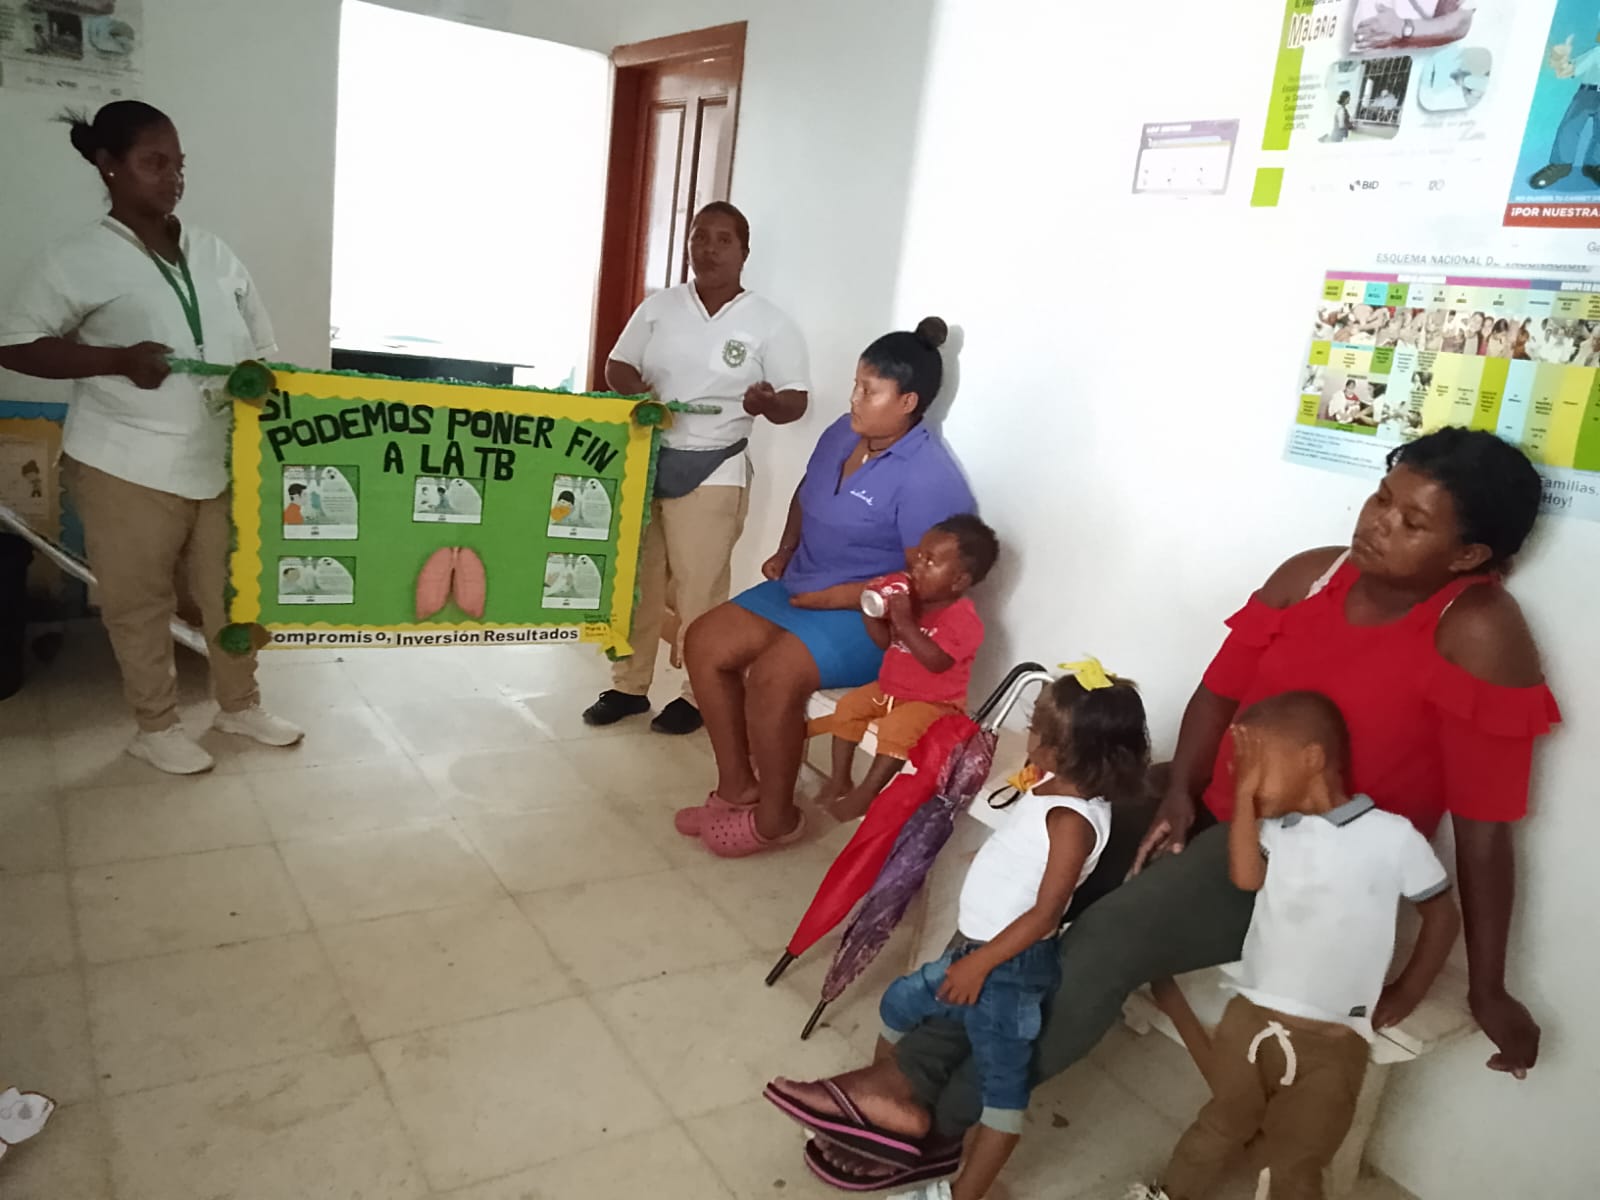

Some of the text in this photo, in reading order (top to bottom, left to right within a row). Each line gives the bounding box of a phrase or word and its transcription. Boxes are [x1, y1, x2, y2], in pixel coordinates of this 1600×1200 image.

[1375, 253, 1427, 264] ESQUEMA
[1430, 255, 1482, 266] NACIONAL
[266, 401, 619, 474] PODEMOS PONER FIN
[383, 441, 516, 481] A LA TB
[1541, 476, 1600, 496] amilias,
[271, 628, 578, 646] ompromiso, Inversión Resultados
